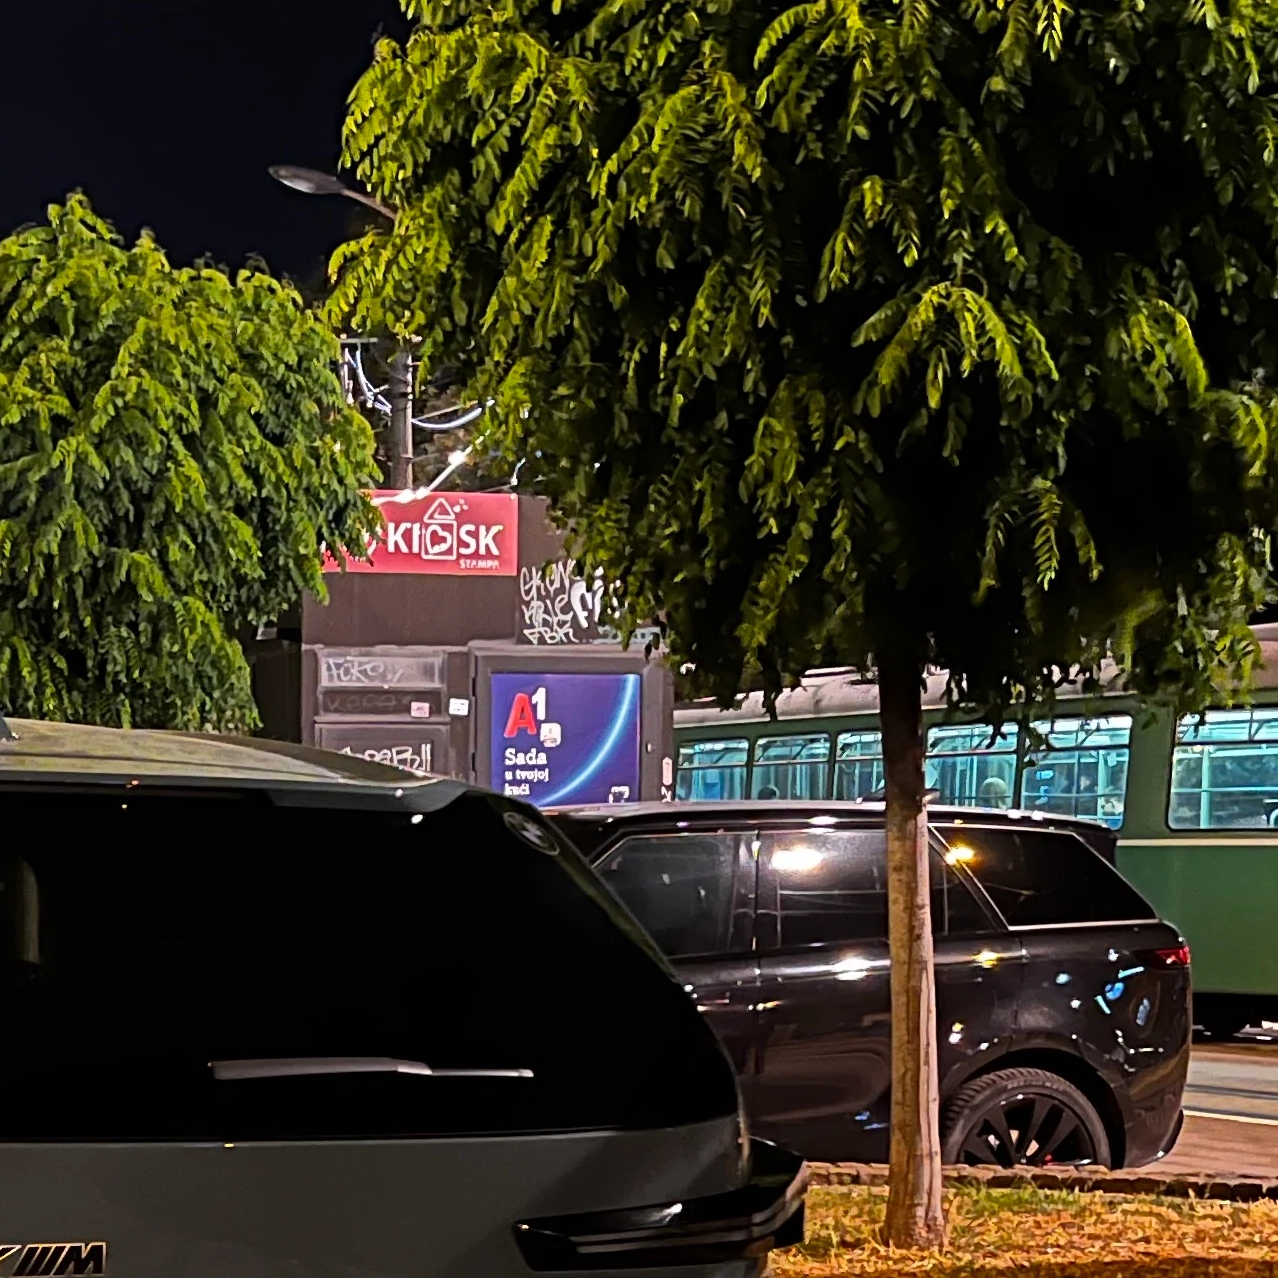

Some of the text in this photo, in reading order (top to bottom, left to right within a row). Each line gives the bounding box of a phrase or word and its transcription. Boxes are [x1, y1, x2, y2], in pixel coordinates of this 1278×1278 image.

[503, 687, 547, 738] A1
[504, 747, 548, 766] Sada
[504, 768, 550, 783] u tvojoj
